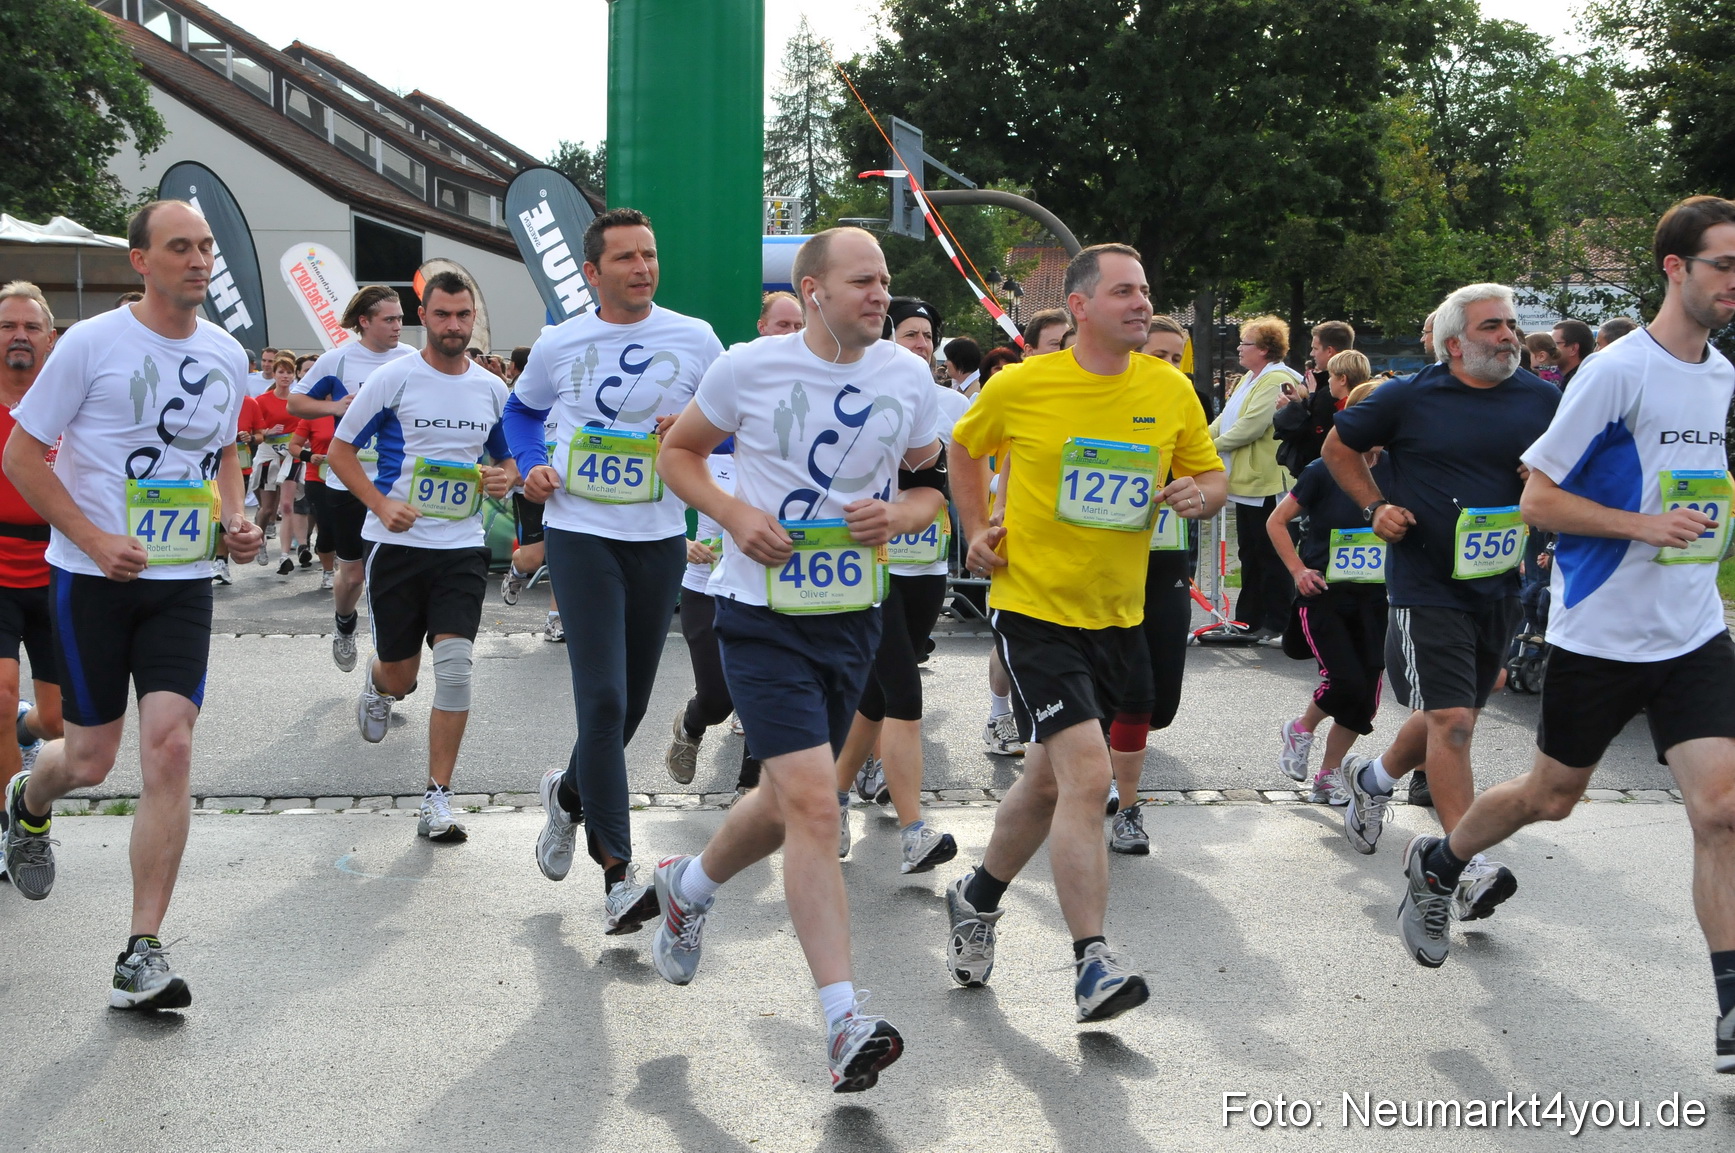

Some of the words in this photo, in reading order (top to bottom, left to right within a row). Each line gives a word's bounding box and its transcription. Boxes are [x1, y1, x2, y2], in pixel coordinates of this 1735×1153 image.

[415, 418, 488, 433] DELPHI
[1133, 416, 1156, 424] KANN
[577, 453, 644, 488] 465
[418, 478, 468, 505] 918
[587, 484, 616, 494] Michael
[1065, 469, 1150, 508] 1273
[422, 502, 446, 511] Andreas
[1081, 505, 1108, 515] Martin
[136, 509, 201, 542] 474
[146, 544, 171, 552] Robert
[1463, 529, 1517, 560] 556
[1335, 547, 1382, 569] 553
[779, 550, 863, 588] 466
[800, 590, 829, 599] Oliver
